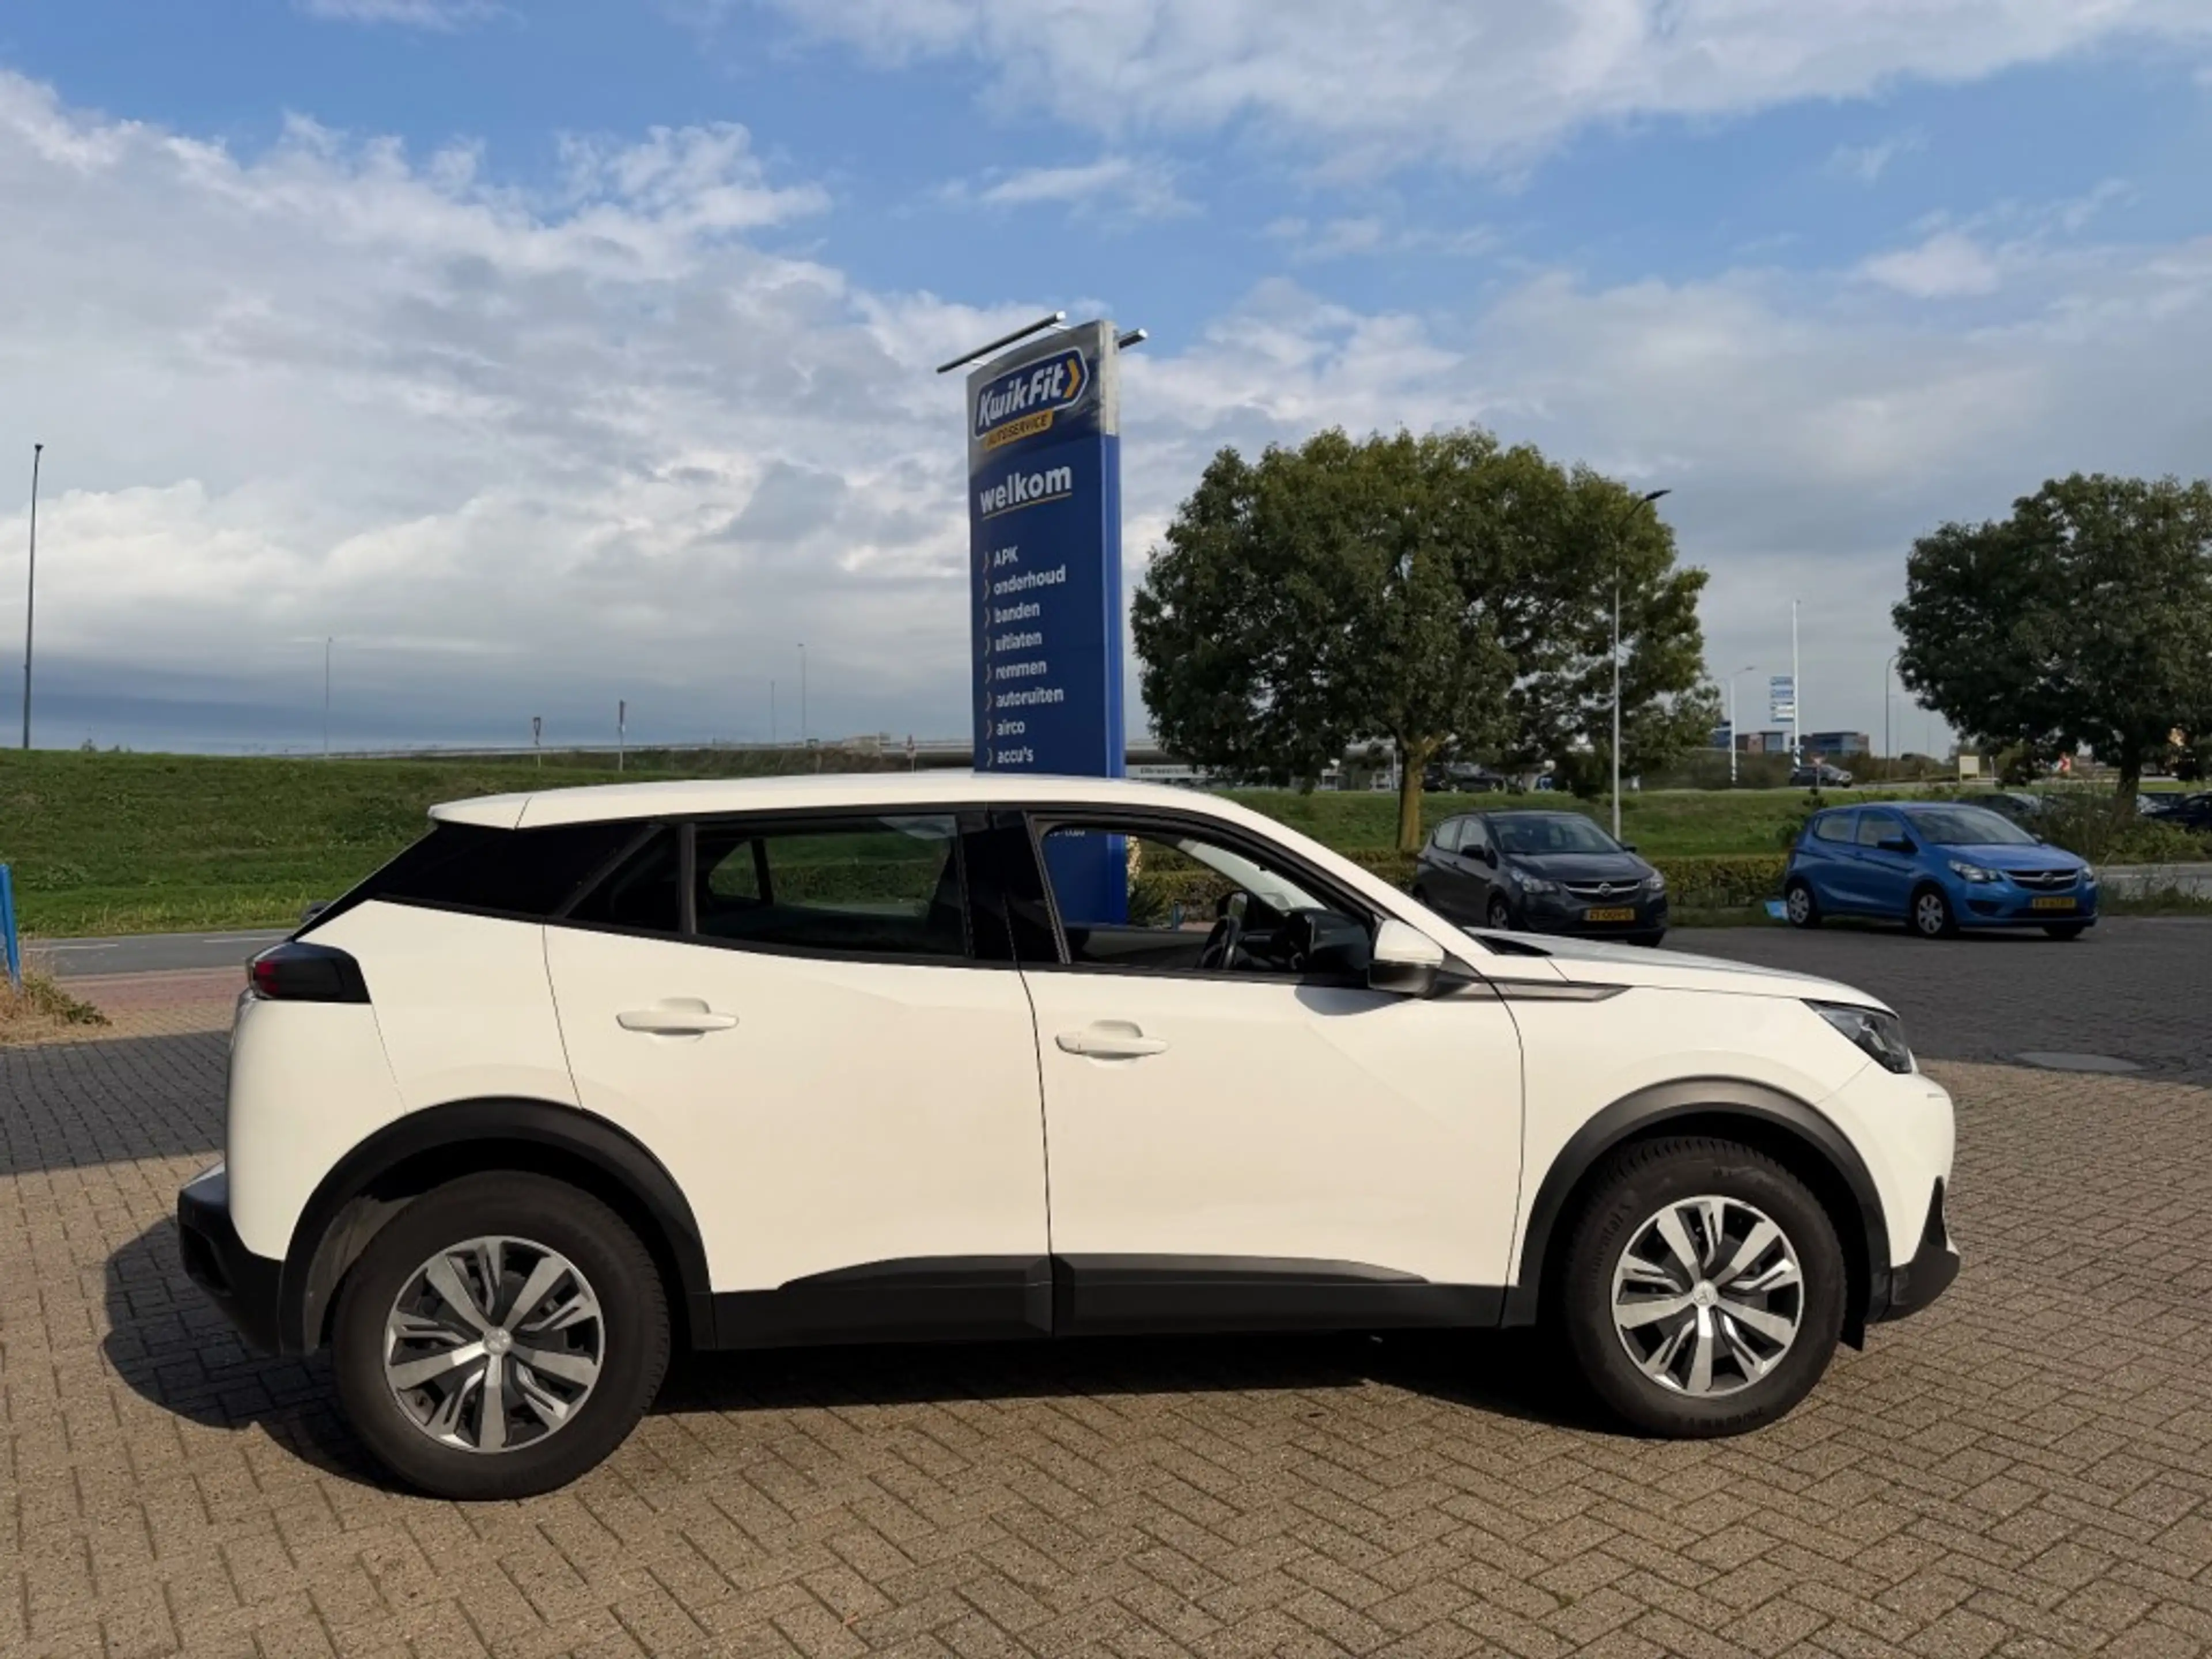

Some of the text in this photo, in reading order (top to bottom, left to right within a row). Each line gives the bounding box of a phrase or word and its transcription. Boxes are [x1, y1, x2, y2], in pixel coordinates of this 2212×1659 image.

[979, 362, 1064, 427] Kwik Fit
[987, 413, 1047, 446] AUTOSERVICE
[980, 466, 1072, 513] welkom
[994, 545, 1018, 568] APK
[994, 564, 1066, 596] onderhoud
[994, 602, 1040, 623] banden
[995, 631, 1043, 652] uitlaten
[995, 661, 1047, 680] remmen
[996, 687, 1064, 707] autoruiten
[997, 719, 1025, 736] airco
[998, 745, 1034, 763] accu's
